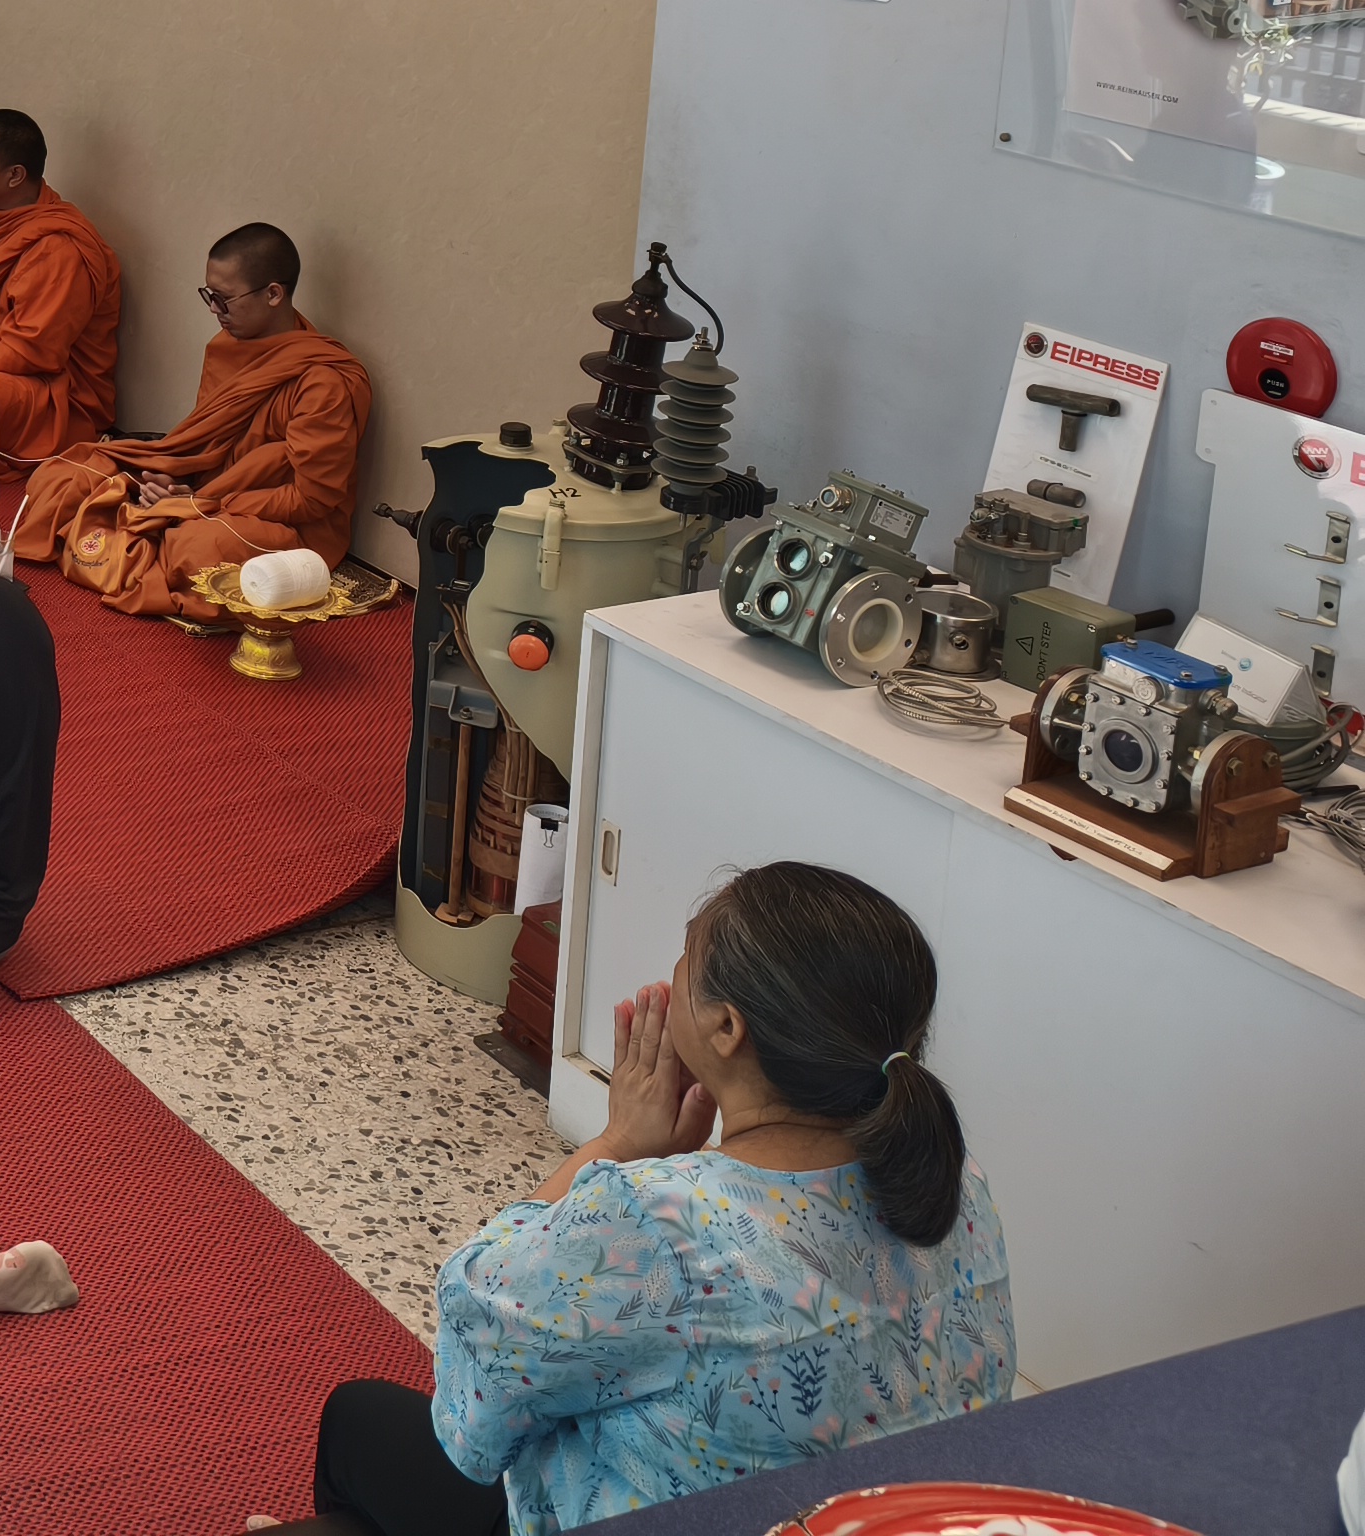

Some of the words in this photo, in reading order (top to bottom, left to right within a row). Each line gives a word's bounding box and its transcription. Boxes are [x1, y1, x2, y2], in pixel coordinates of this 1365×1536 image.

[1050, 341, 1161, 390] ELPRESS
[548, 487, 582, 499] H2
[1041, 621, 1052, 649] STEP
